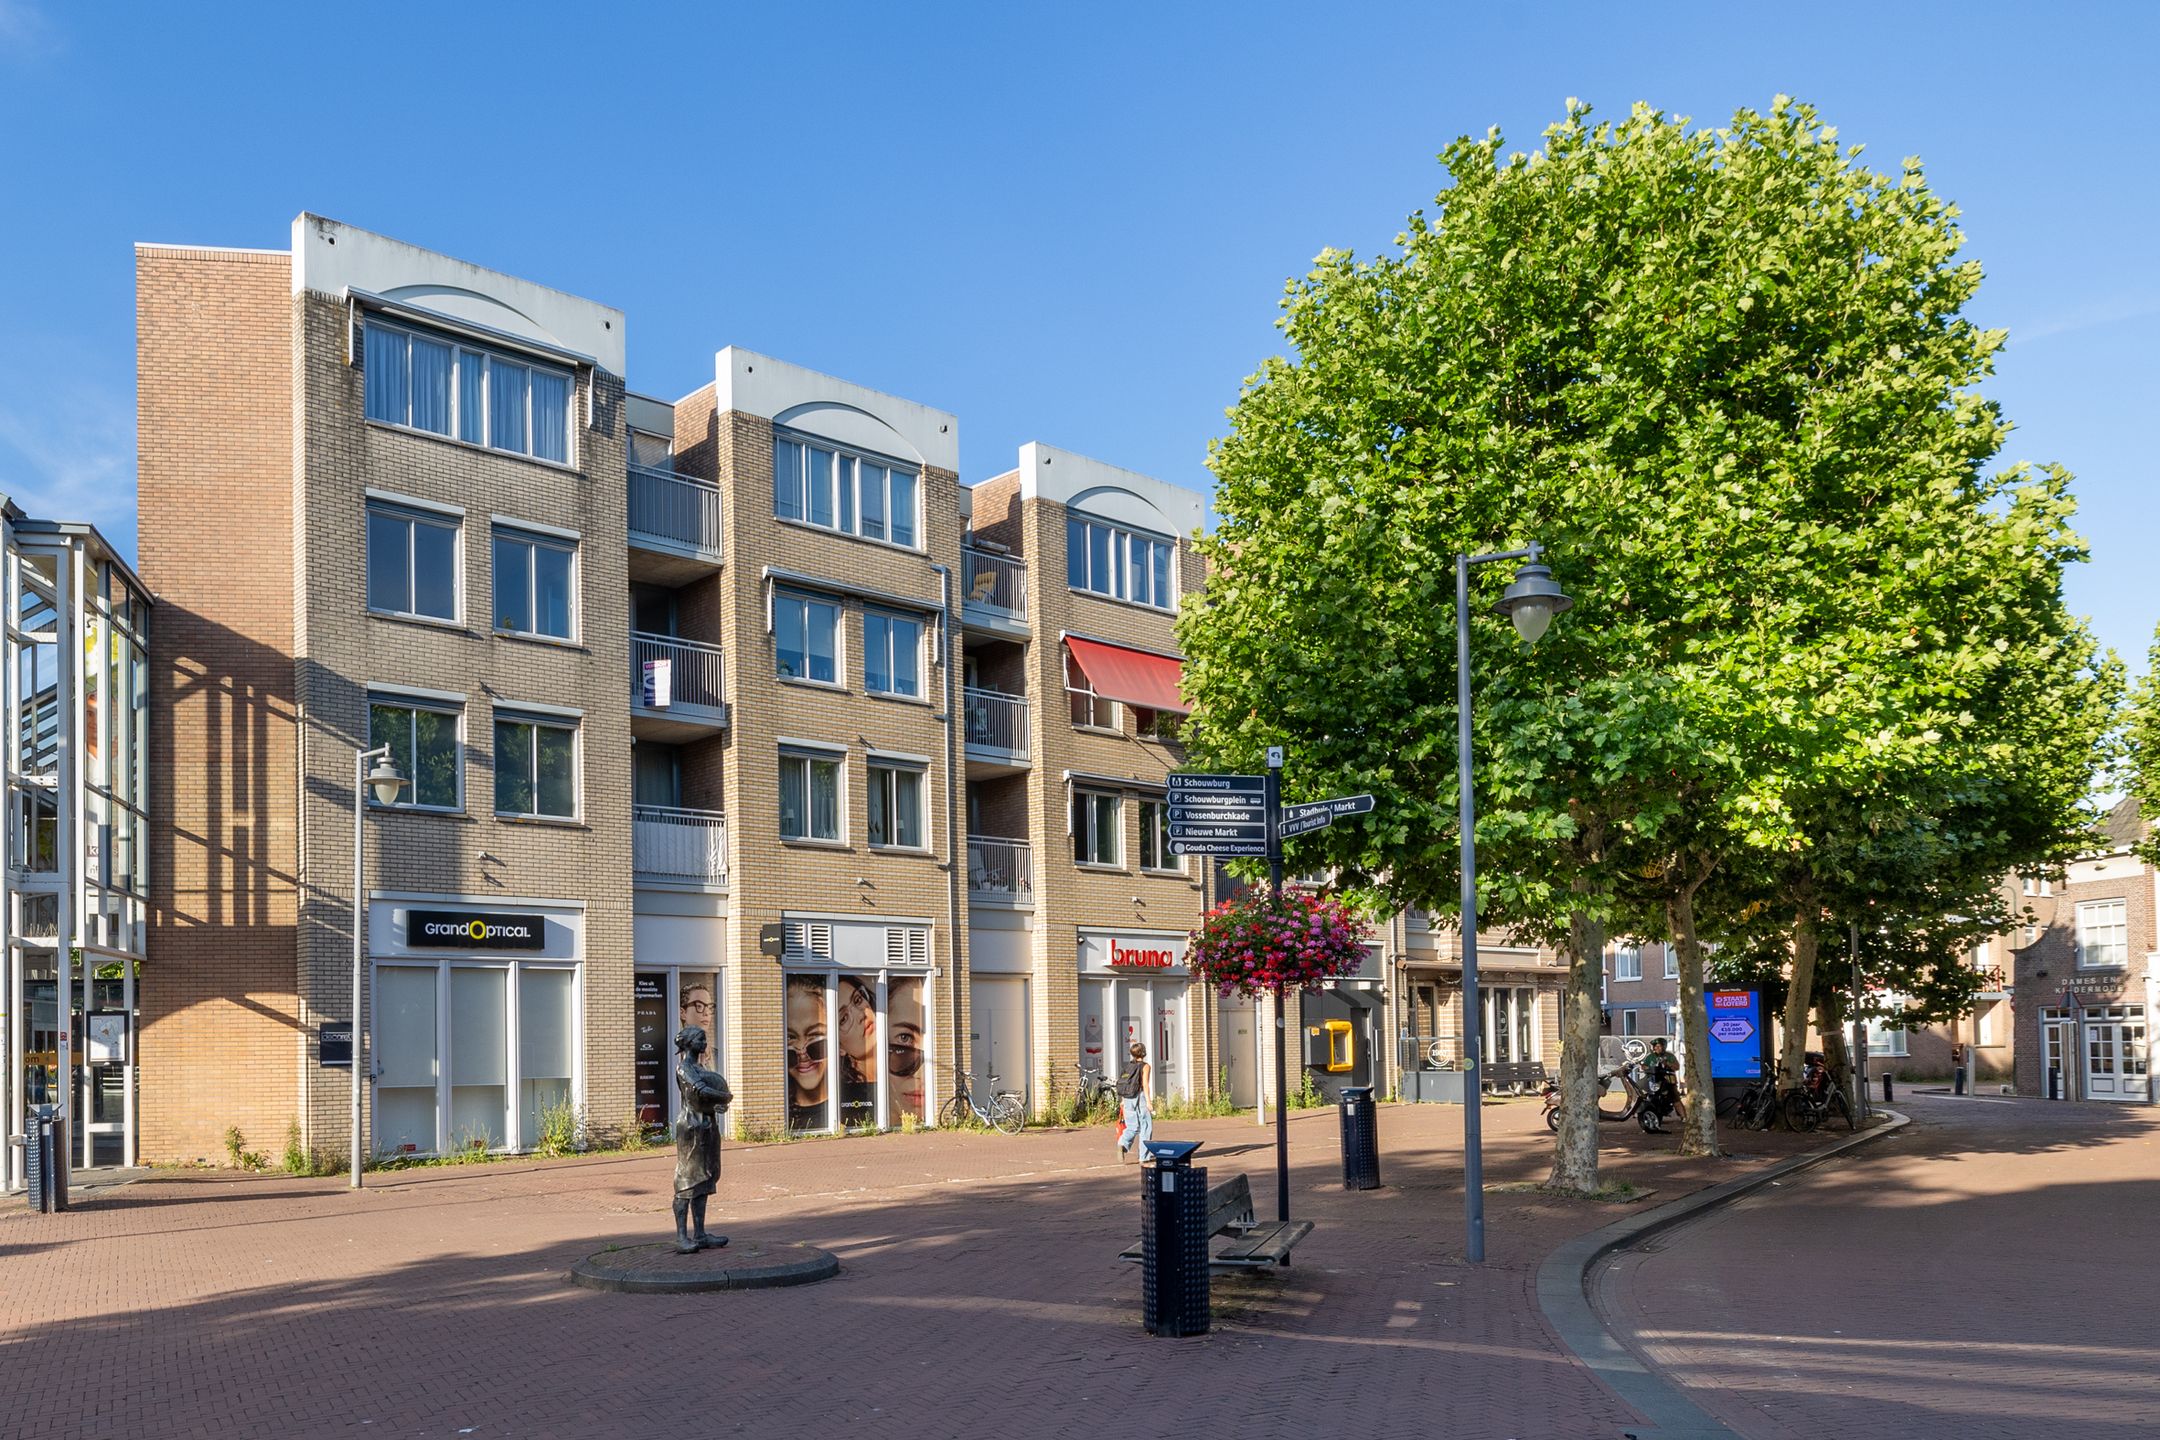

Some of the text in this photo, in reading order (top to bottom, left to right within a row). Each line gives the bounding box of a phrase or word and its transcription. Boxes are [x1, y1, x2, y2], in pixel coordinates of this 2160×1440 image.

[1184, 778, 1230, 789] Schouwburg
[1184, 795, 1246, 805] Schouwburgplein
[1334, 802, 1356, 812] Markt
[1185, 811, 1250, 820] Vossenburchkade
[1289, 822, 1299, 832] VVV
[1317, 816, 1325, 824] Info
[1215, 828, 1238, 836] Markt
[1111, 938, 1172, 967] bruna
[2062, 977, 2096, 986] DAMES
[2055, 985, 2124, 994] KIDERMODE
